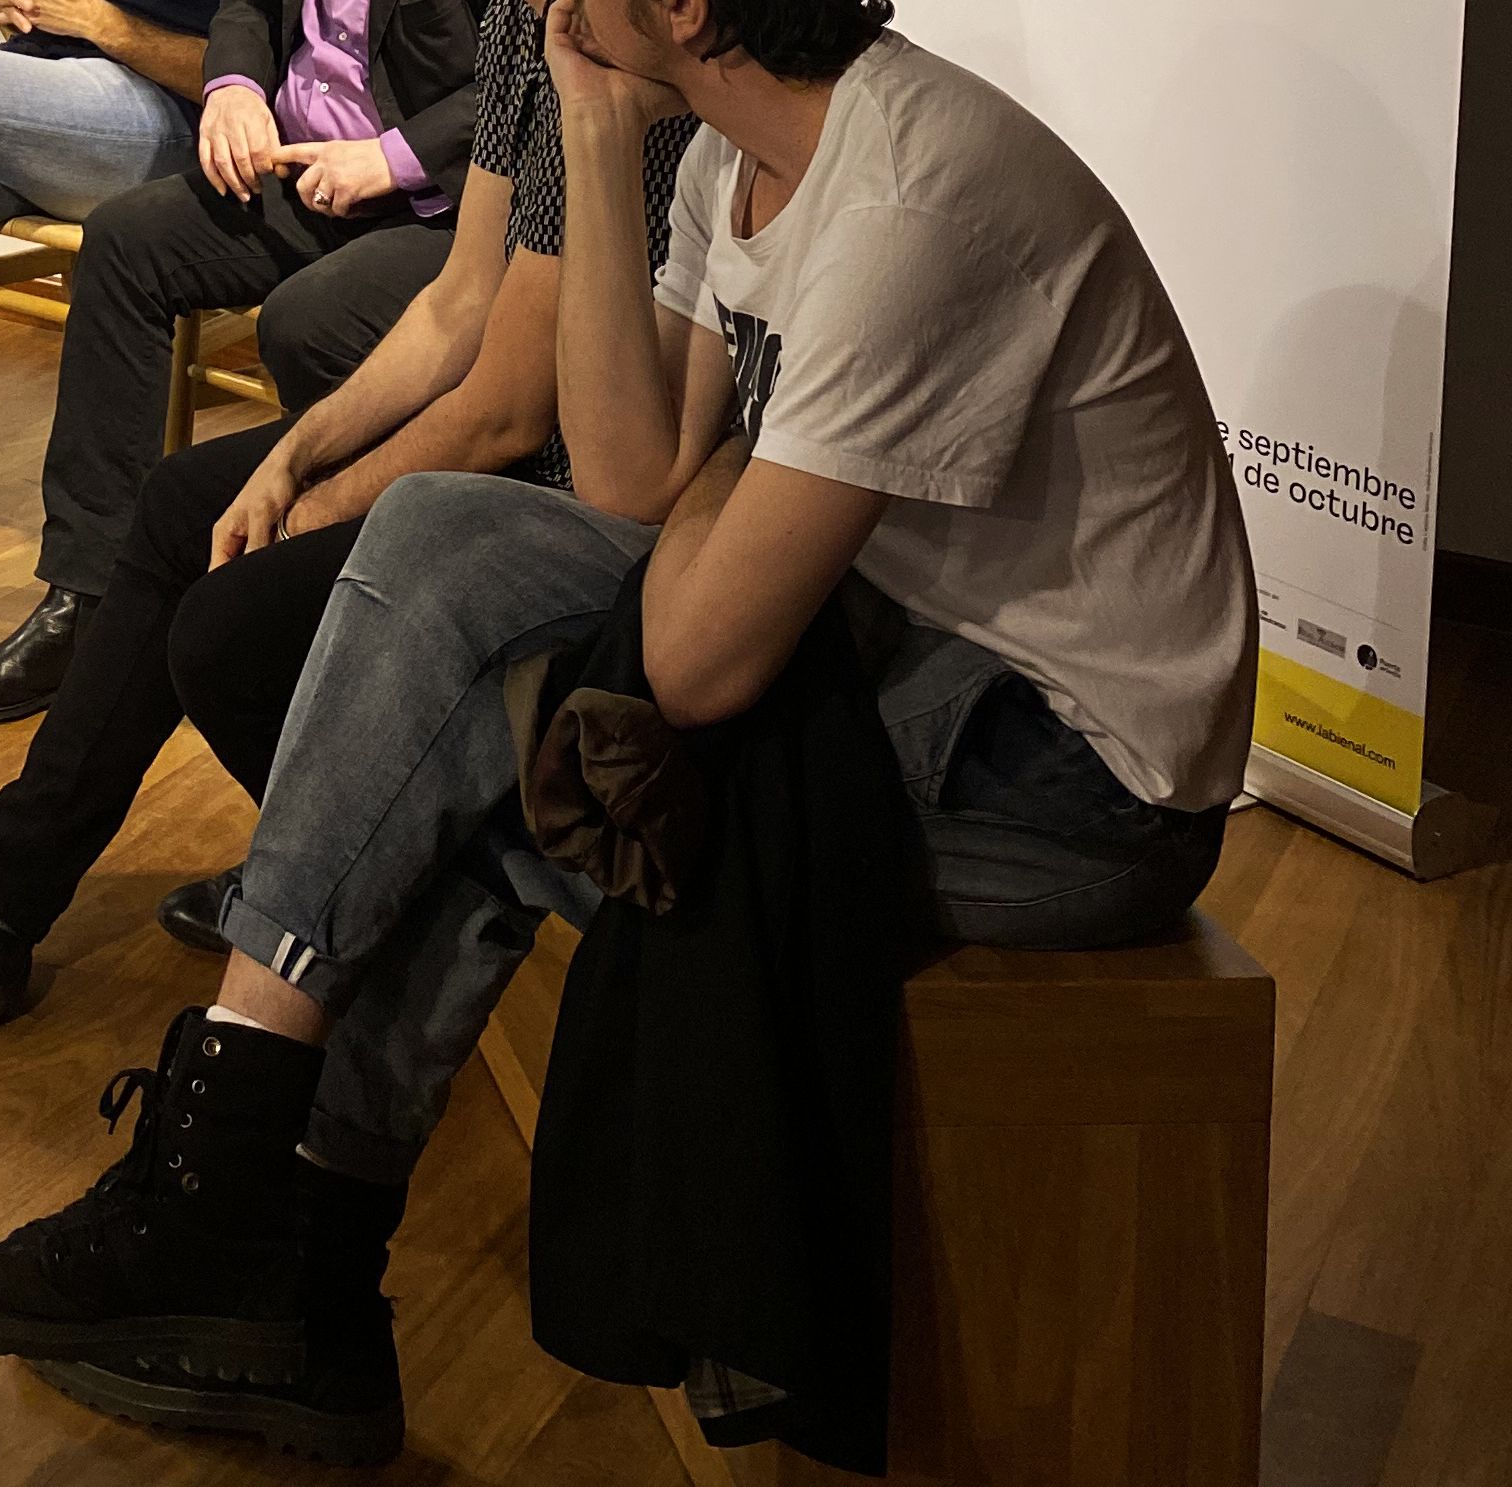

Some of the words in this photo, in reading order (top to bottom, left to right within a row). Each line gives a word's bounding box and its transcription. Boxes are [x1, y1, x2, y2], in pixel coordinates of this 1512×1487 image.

[1216, 421, 1229, 441] e
[1238, 429, 1416, 510] septiembre
[1244, 462, 1279, 494] de
[1289, 482, 1414, 545] octubre
[1284, 712, 1396, 770] www.labienal.com
